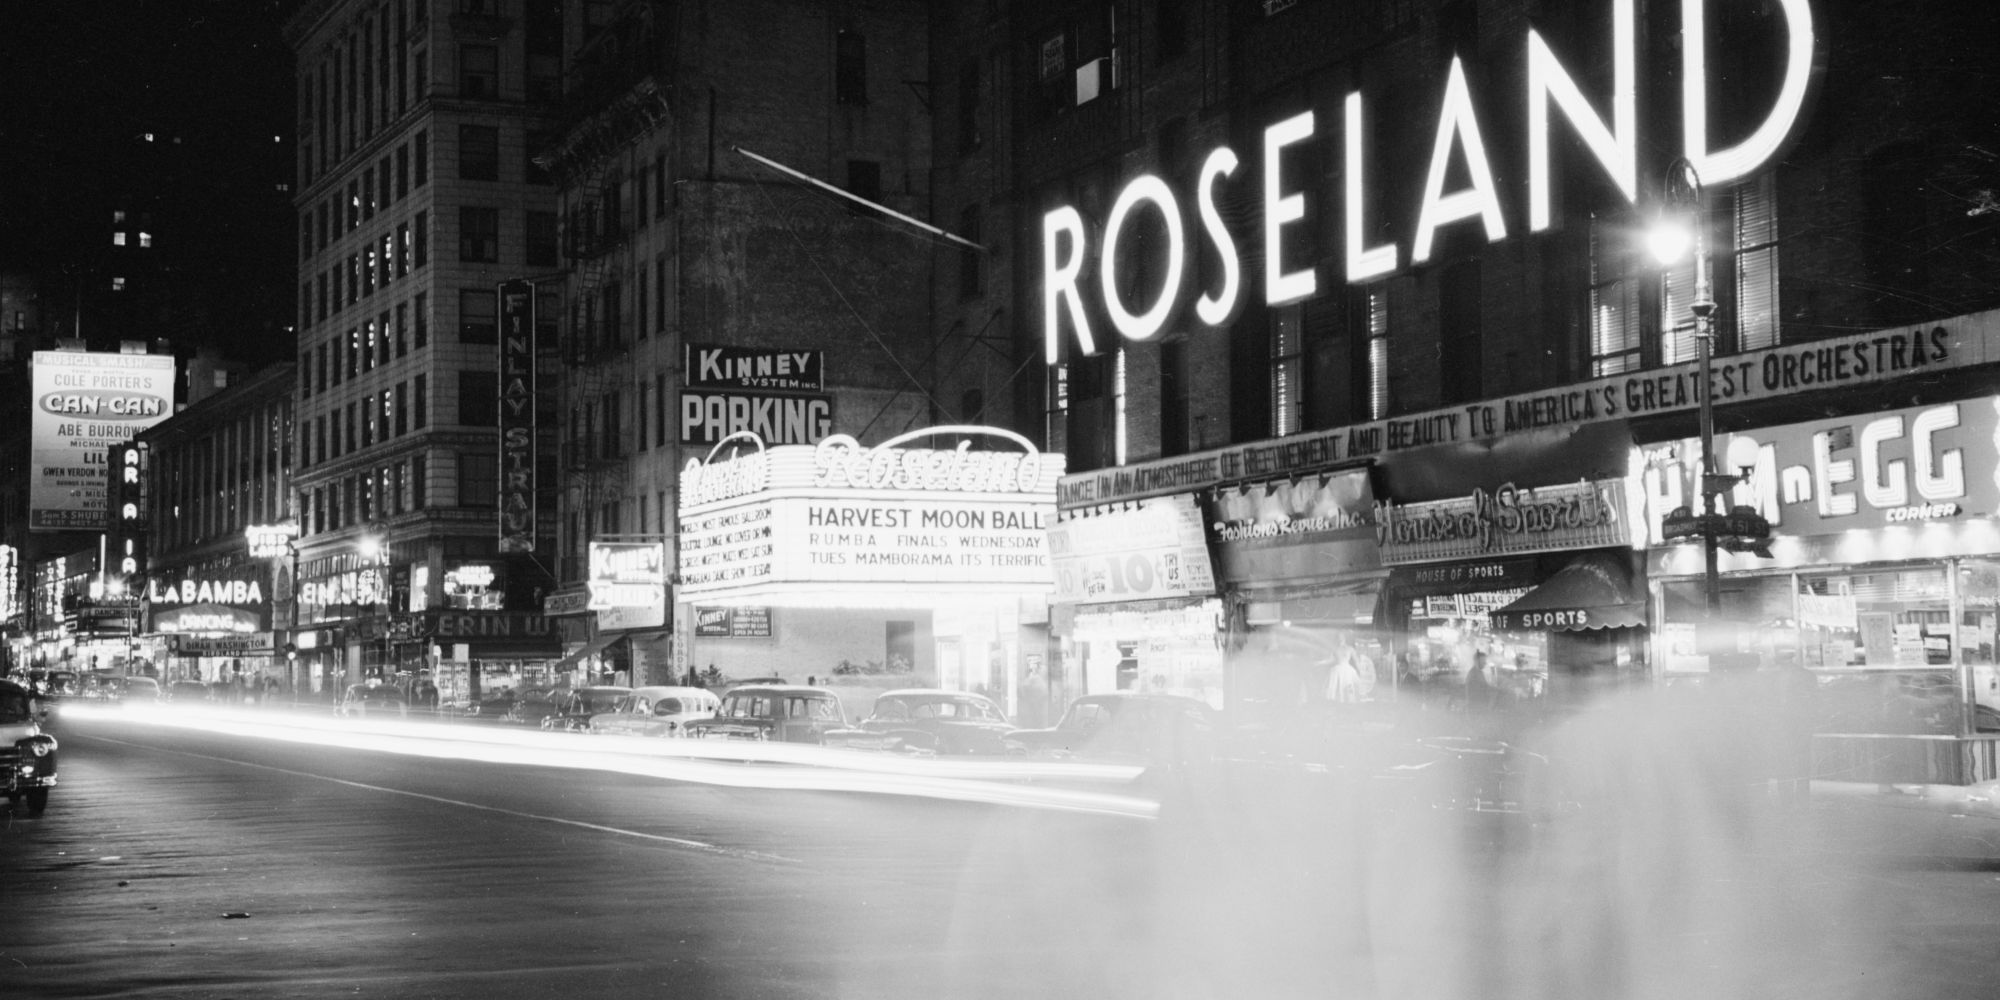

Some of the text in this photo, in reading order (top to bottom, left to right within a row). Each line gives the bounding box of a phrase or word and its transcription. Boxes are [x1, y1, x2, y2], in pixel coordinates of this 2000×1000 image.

[1043, 0, 1814, 364] ROSELAND
[505, 293, 529, 416] FINLAY
[700, 348, 811, 381] KINNEY
[54, 374, 86, 387] COLE
[742, 377, 799, 389] SYSTEM
[45, 394, 162, 416] CAN-CAN
[1220, 451, 1240, 479] OF
[1242, 433, 1342, 476] REFINEMENT
[1347, 427, 1380, 460] AND
[1387, 413, 1457, 450] BEAUTY
[1466, 405, 1495, 438] TO
[1503, 385, 1616, 432] AMERICA'S
[1625, 362, 1756, 413] GREATEST
[1762, 326, 1950, 391] ORCHESTRAS
[682, 394, 832, 445] PARKING
[57, 424, 83, 437] ABE
[1813, 403, 1967, 519] EGG
[43, 467, 65, 478] GWEN
[67, 467, 97, 478] VERDON
[808, 506, 1046, 531] HARVEST MOON BALL
[1372, 480, 1620, 551] House of Sports
[1886, 503, 1958, 523] CORNER
[1214, 519, 1280, 541] Fashions
[1336, 507, 1367, 530] Inc.
[809, 533, 878, 547] RUMBA
[896, 534, 949, 549] FINALS
[959, 535, 1042, 550] WEDNESDAY
[809, 551, 1047, 568] TUES MAMBORAMA ITS TERRIFIC
[1168, 567, 1180, 580] US
[1415, 563, 1504, 582] HOUSE OF SPORTS
[150, 579, 262, 604] LA BAMBA
[695, 609, 727, 627] KINNEY
[1523, 608, 1587, 628] SPORTS
[186, 639, 266, 650] DINAH WASHINGTON
